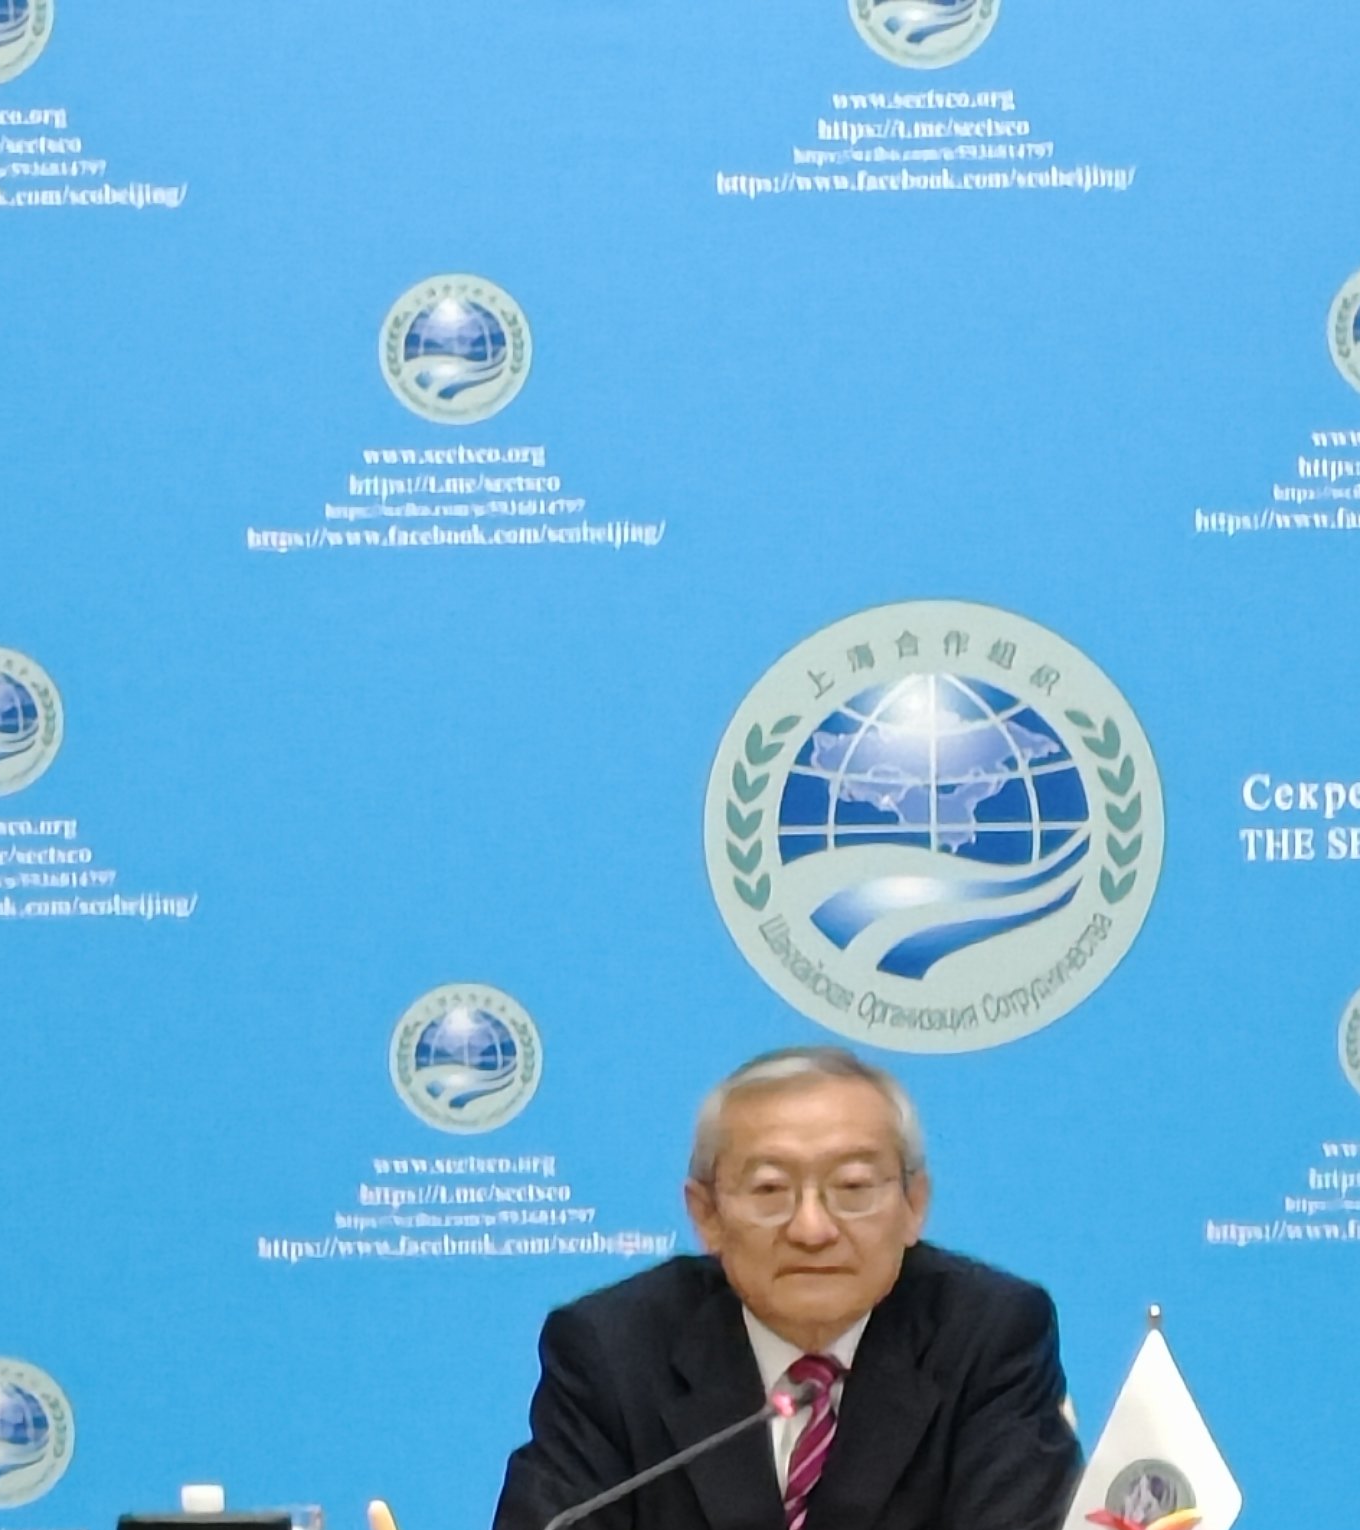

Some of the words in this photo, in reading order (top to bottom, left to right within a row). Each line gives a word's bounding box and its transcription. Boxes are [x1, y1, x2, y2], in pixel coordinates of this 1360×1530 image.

[832, 88, 1018, 113] www.sectsco.org
[716, 164, 1138, 201] https://www.facebook.com/scobeijing/
[362, 446, 548, 469] www.sectsco.org
[246, 520, 668, 555] https://www.facebook.com/scobeijing/
[1239, 827, 1317, 864] THE
[372, 1155, 558, 1179] www.sectsco.org
[256, 1230, 679, 1266] https://www.facebook.com/scobeijing/
